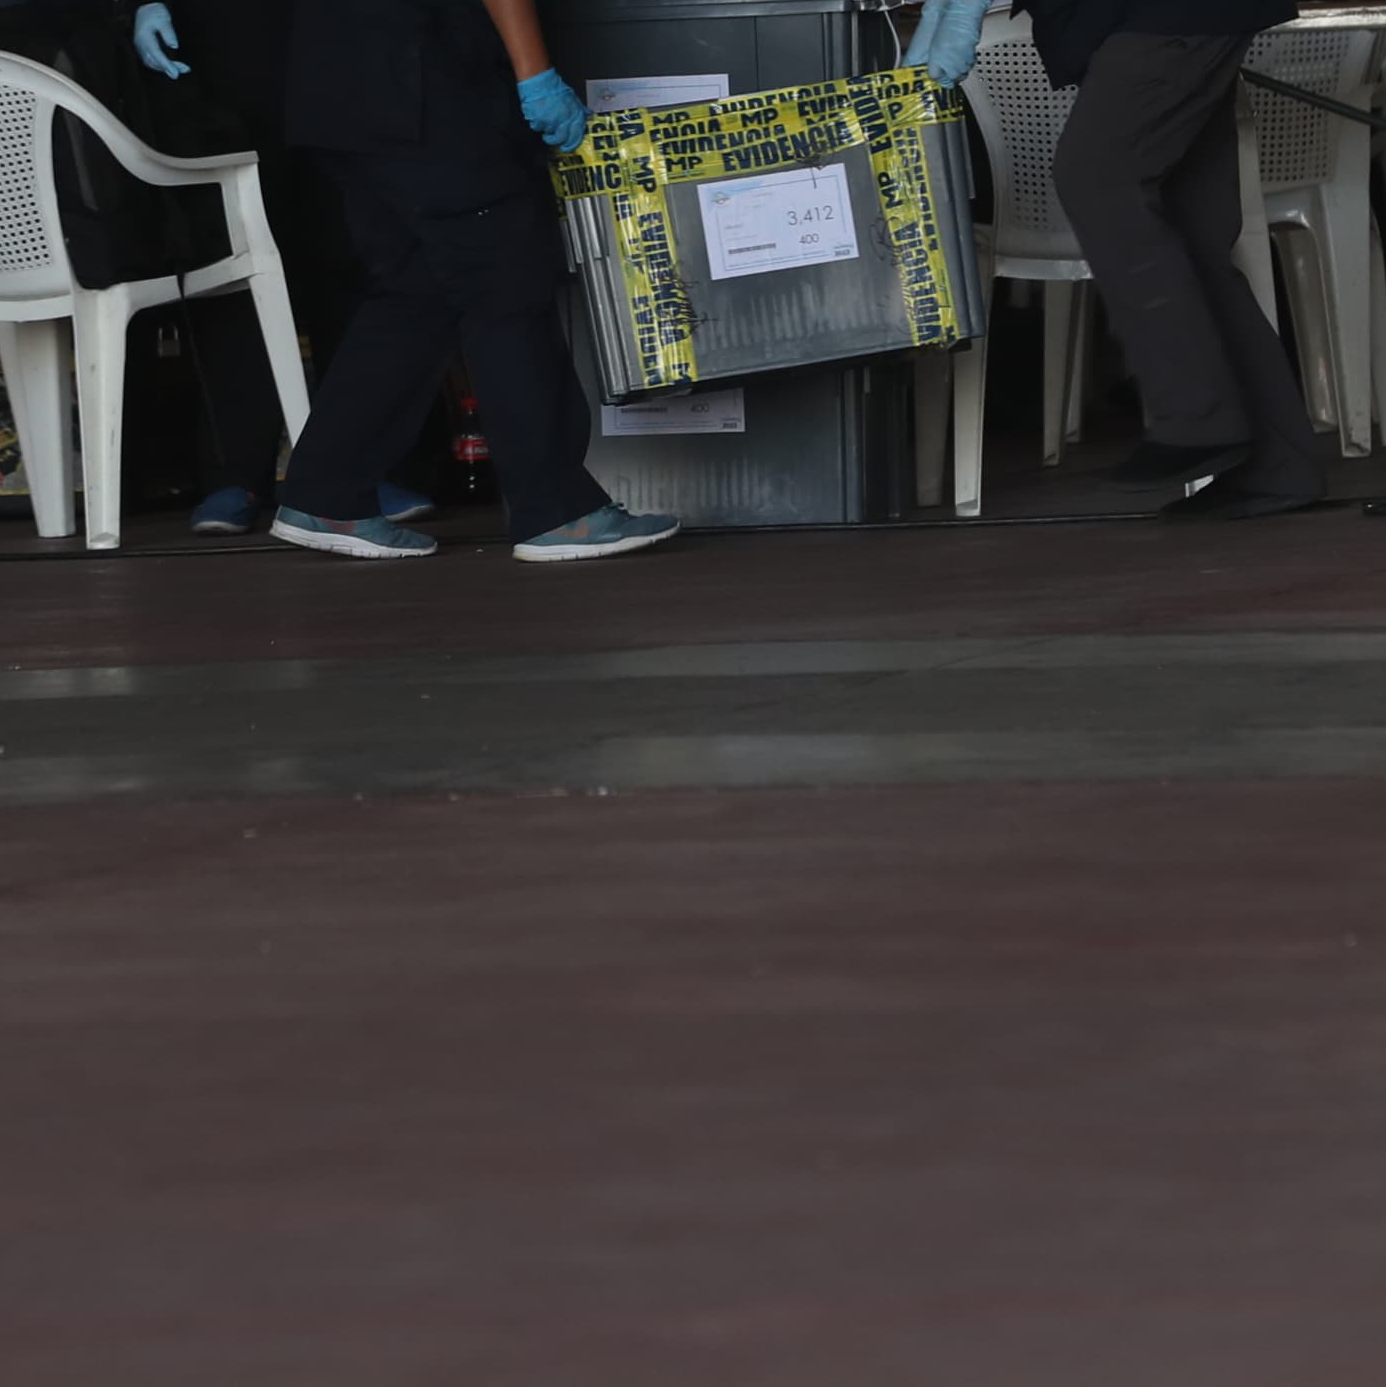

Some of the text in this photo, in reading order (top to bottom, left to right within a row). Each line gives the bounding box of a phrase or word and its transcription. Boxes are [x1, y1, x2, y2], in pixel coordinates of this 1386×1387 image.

[740, 107, 779, 127] MP
[665, 156, 704, 172] MP
[722, 119, 853, 171] EVIDENCIA
[633, 155, 657, 193] MP
[877, 171, 903, 209] MP
[787, 205, 835, 226] 3,412
[799, 233, 820, 245] 400
[637, 211, 686, 347] EVIDENCIA
[893, 220, 942, 344] VIDENCIA
